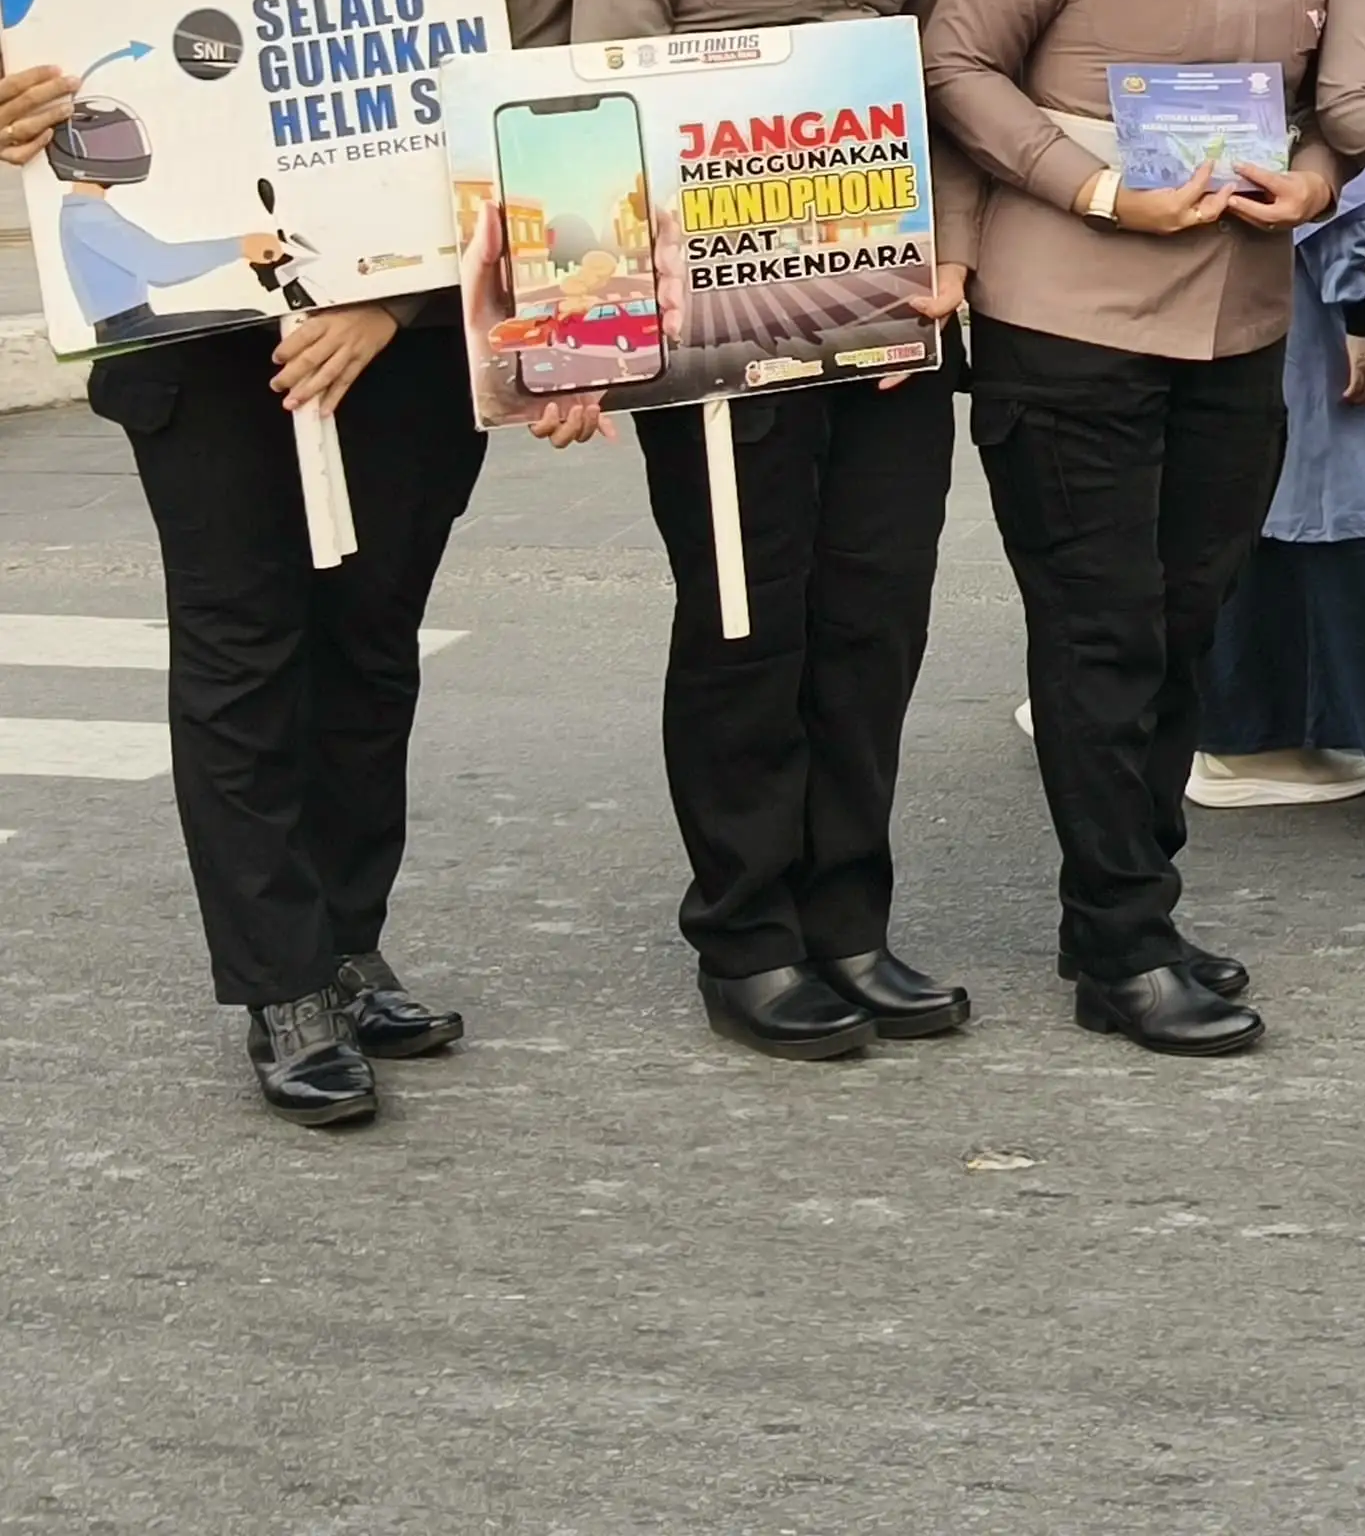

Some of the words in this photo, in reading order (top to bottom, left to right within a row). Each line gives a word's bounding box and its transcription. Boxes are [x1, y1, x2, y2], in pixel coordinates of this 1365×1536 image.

[192, 42, 226, 61] SNI
[258, 16, 488, 94] GUNAKAN
[269, 83, 399, 148] HELM
[410, 78, 442, 126] S
[678, 102, 907, 161] JANGAN
[277, 148, 338, 172] SAAT
[346, 132, 447, 163] BERKEN
[681, 141, 910, 182] MENGGUNAKAN
[682, 168, 916, 232] HANDPHONE
[688, 229, 778, 262] SAAT
[690, 241, 922, 290] BERKENDARA
